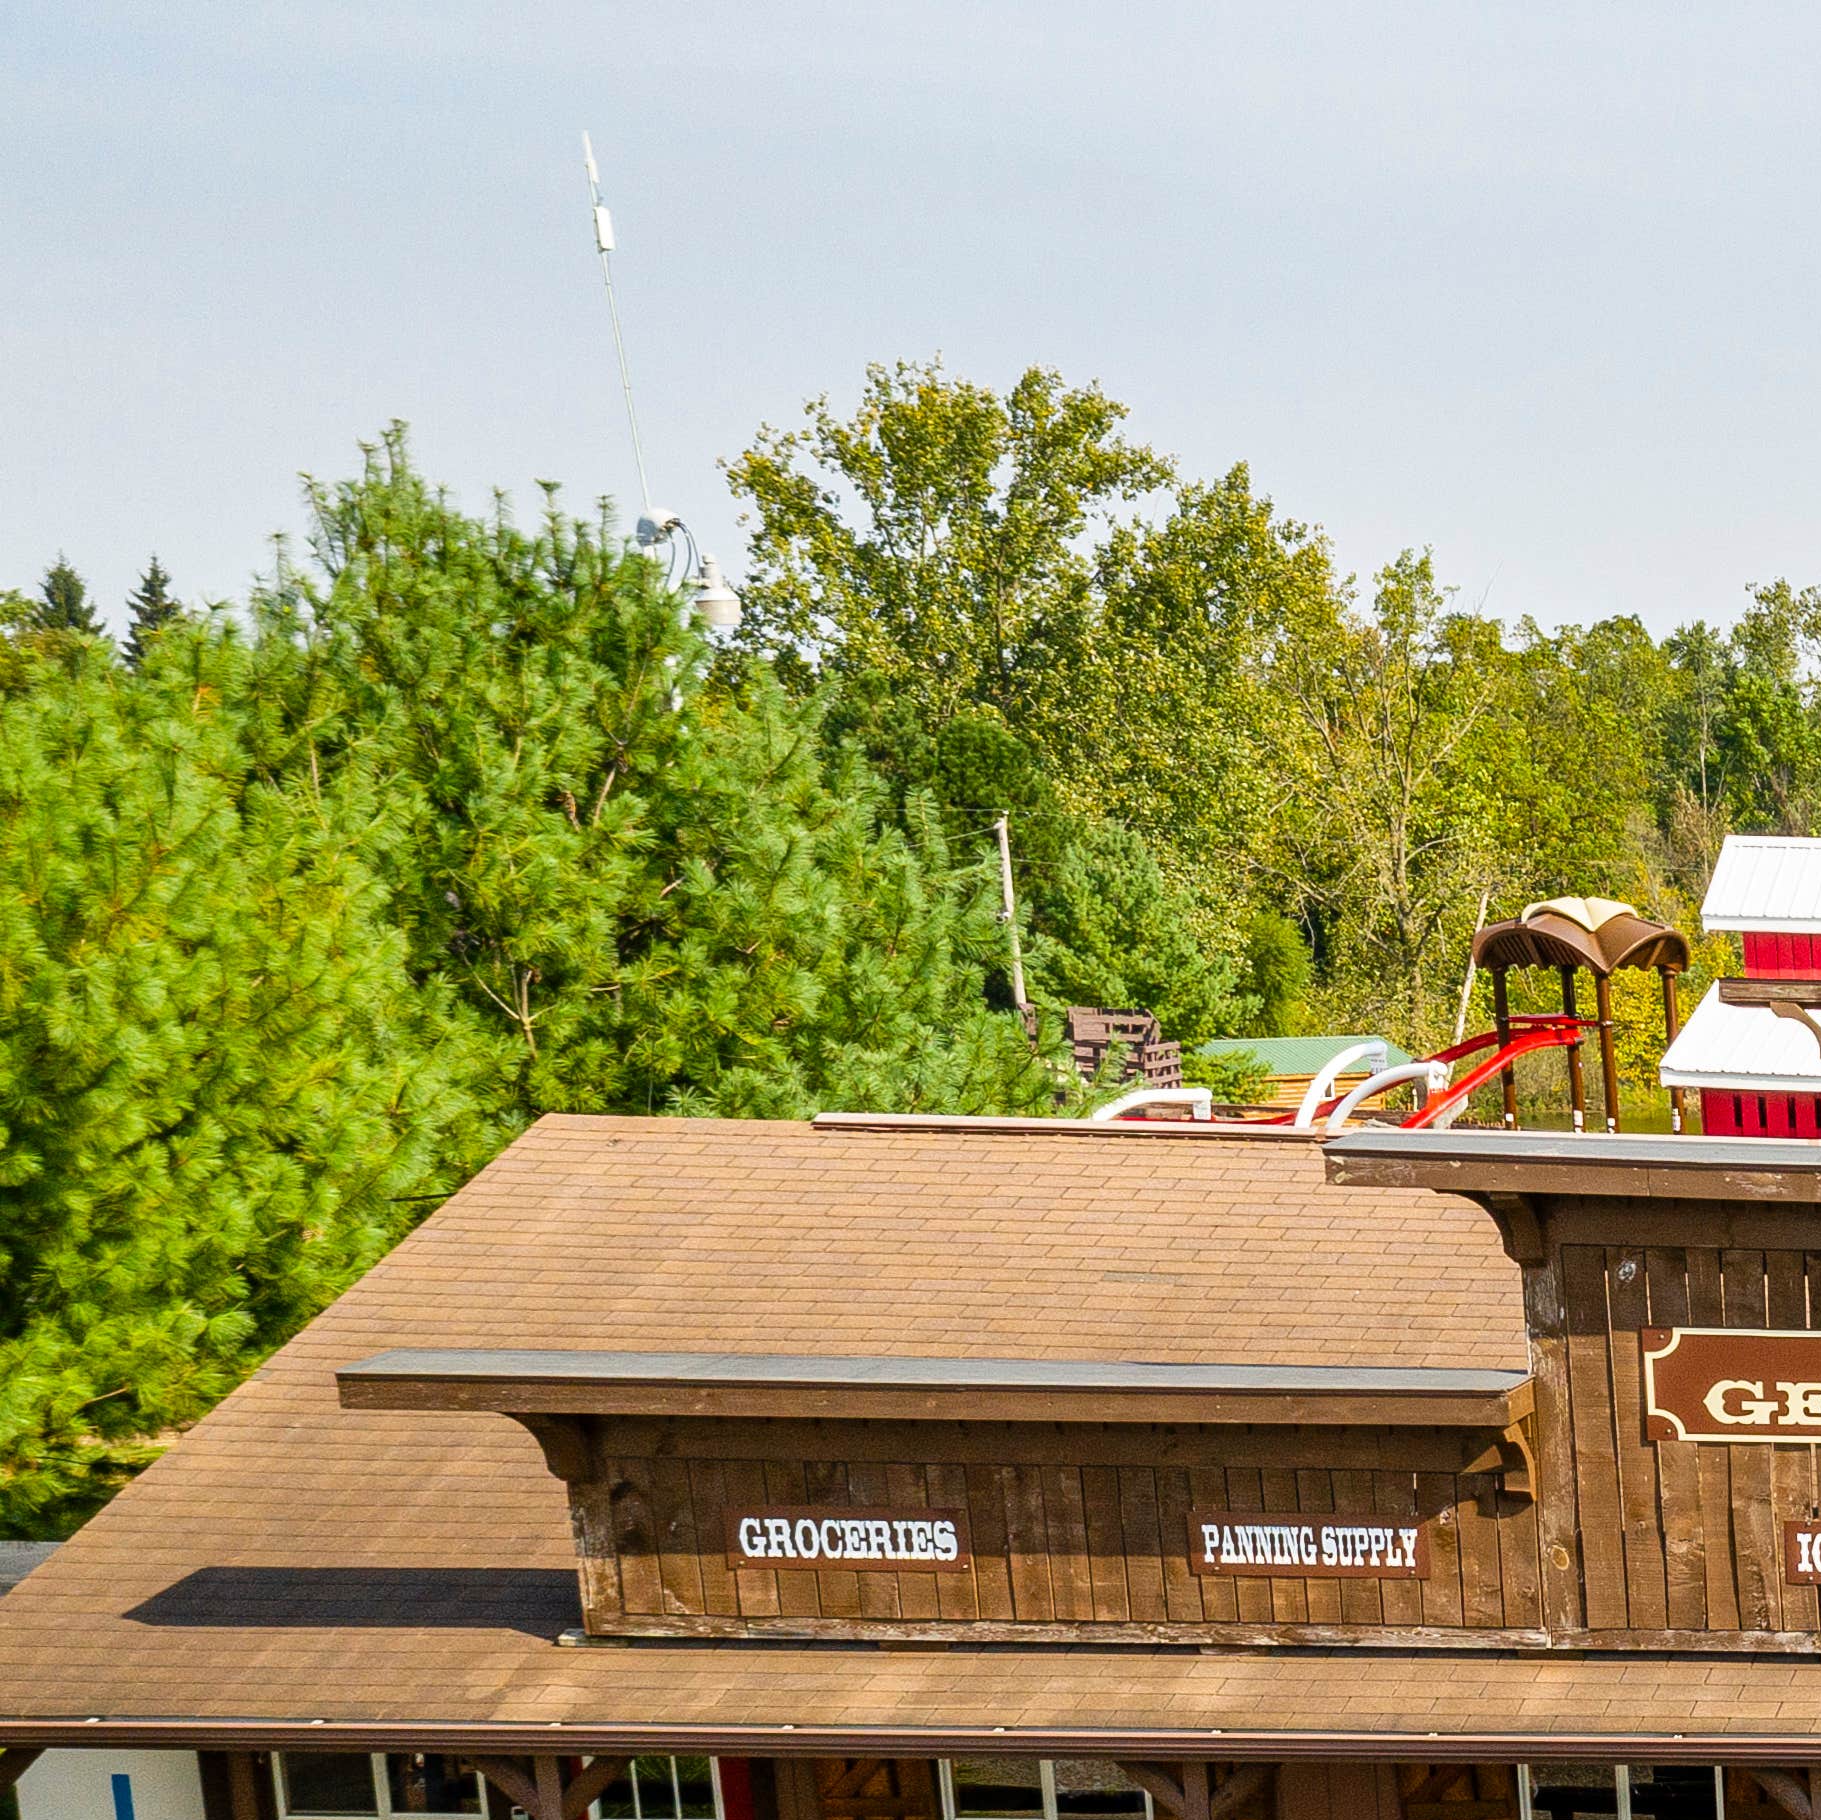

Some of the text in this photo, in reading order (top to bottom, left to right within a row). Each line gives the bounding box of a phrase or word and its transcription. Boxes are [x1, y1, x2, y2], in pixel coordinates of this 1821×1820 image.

[738, 1517, 958, 1563] GROCERIES
[1201, 1524, 1418, 1568] PANNING SUPPLY
